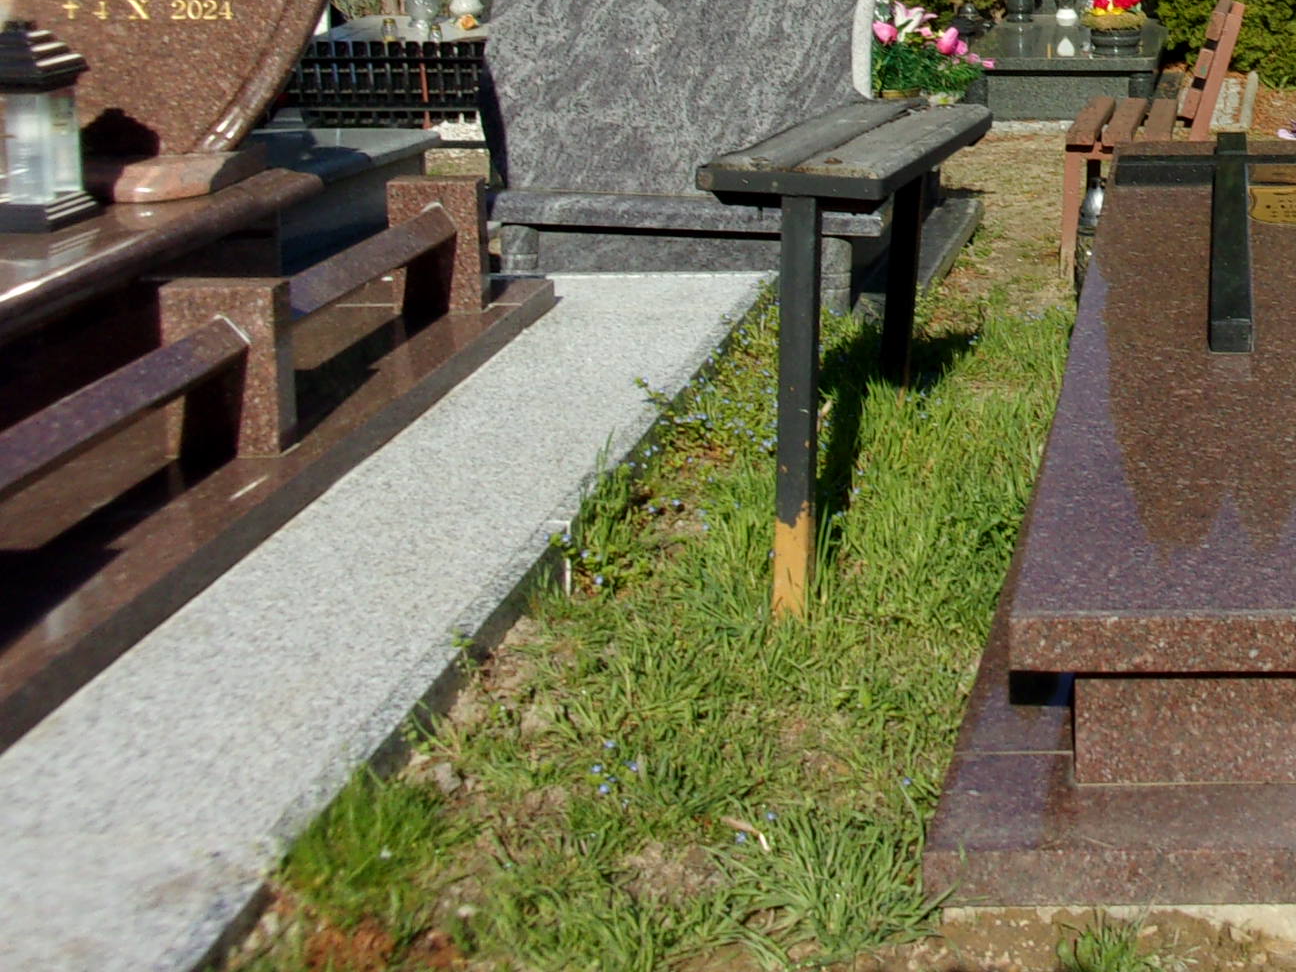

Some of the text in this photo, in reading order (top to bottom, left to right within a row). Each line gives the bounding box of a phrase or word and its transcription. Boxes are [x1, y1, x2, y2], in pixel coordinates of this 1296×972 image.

[95, 0, 233, 21] 4 X 2024
